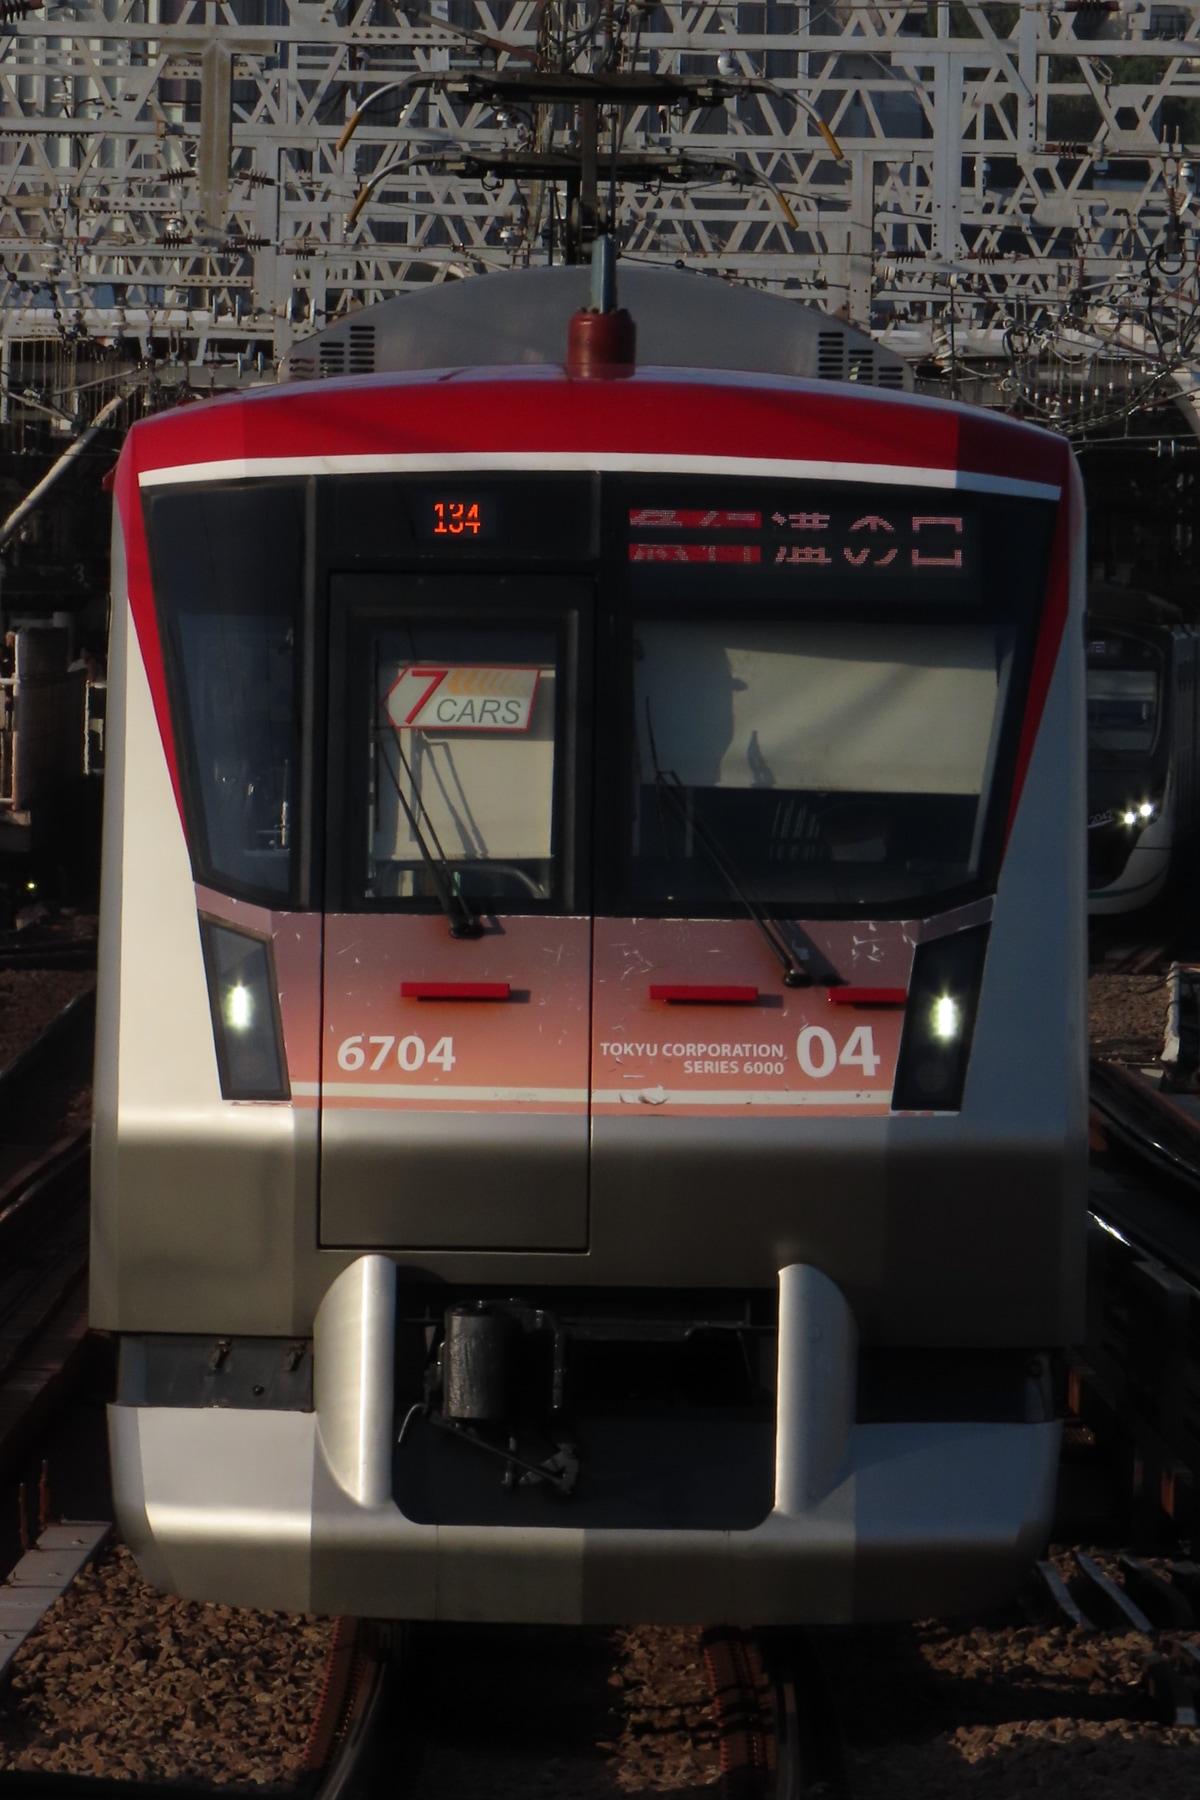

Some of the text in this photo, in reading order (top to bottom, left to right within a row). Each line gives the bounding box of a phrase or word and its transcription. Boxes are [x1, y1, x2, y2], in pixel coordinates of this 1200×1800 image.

[434, 503, 480, 533] 134
[405, 670, 449, 725] 7
[436, 698, 521, 724] CARS
[337, 1035, 456, 1071] 6704
[600, 1042, 783, 1058] TOKYU CORPORATION
[796, 1025, 880, 1078] 04
[683, 1060, 784, 1075] SERIES 6000
